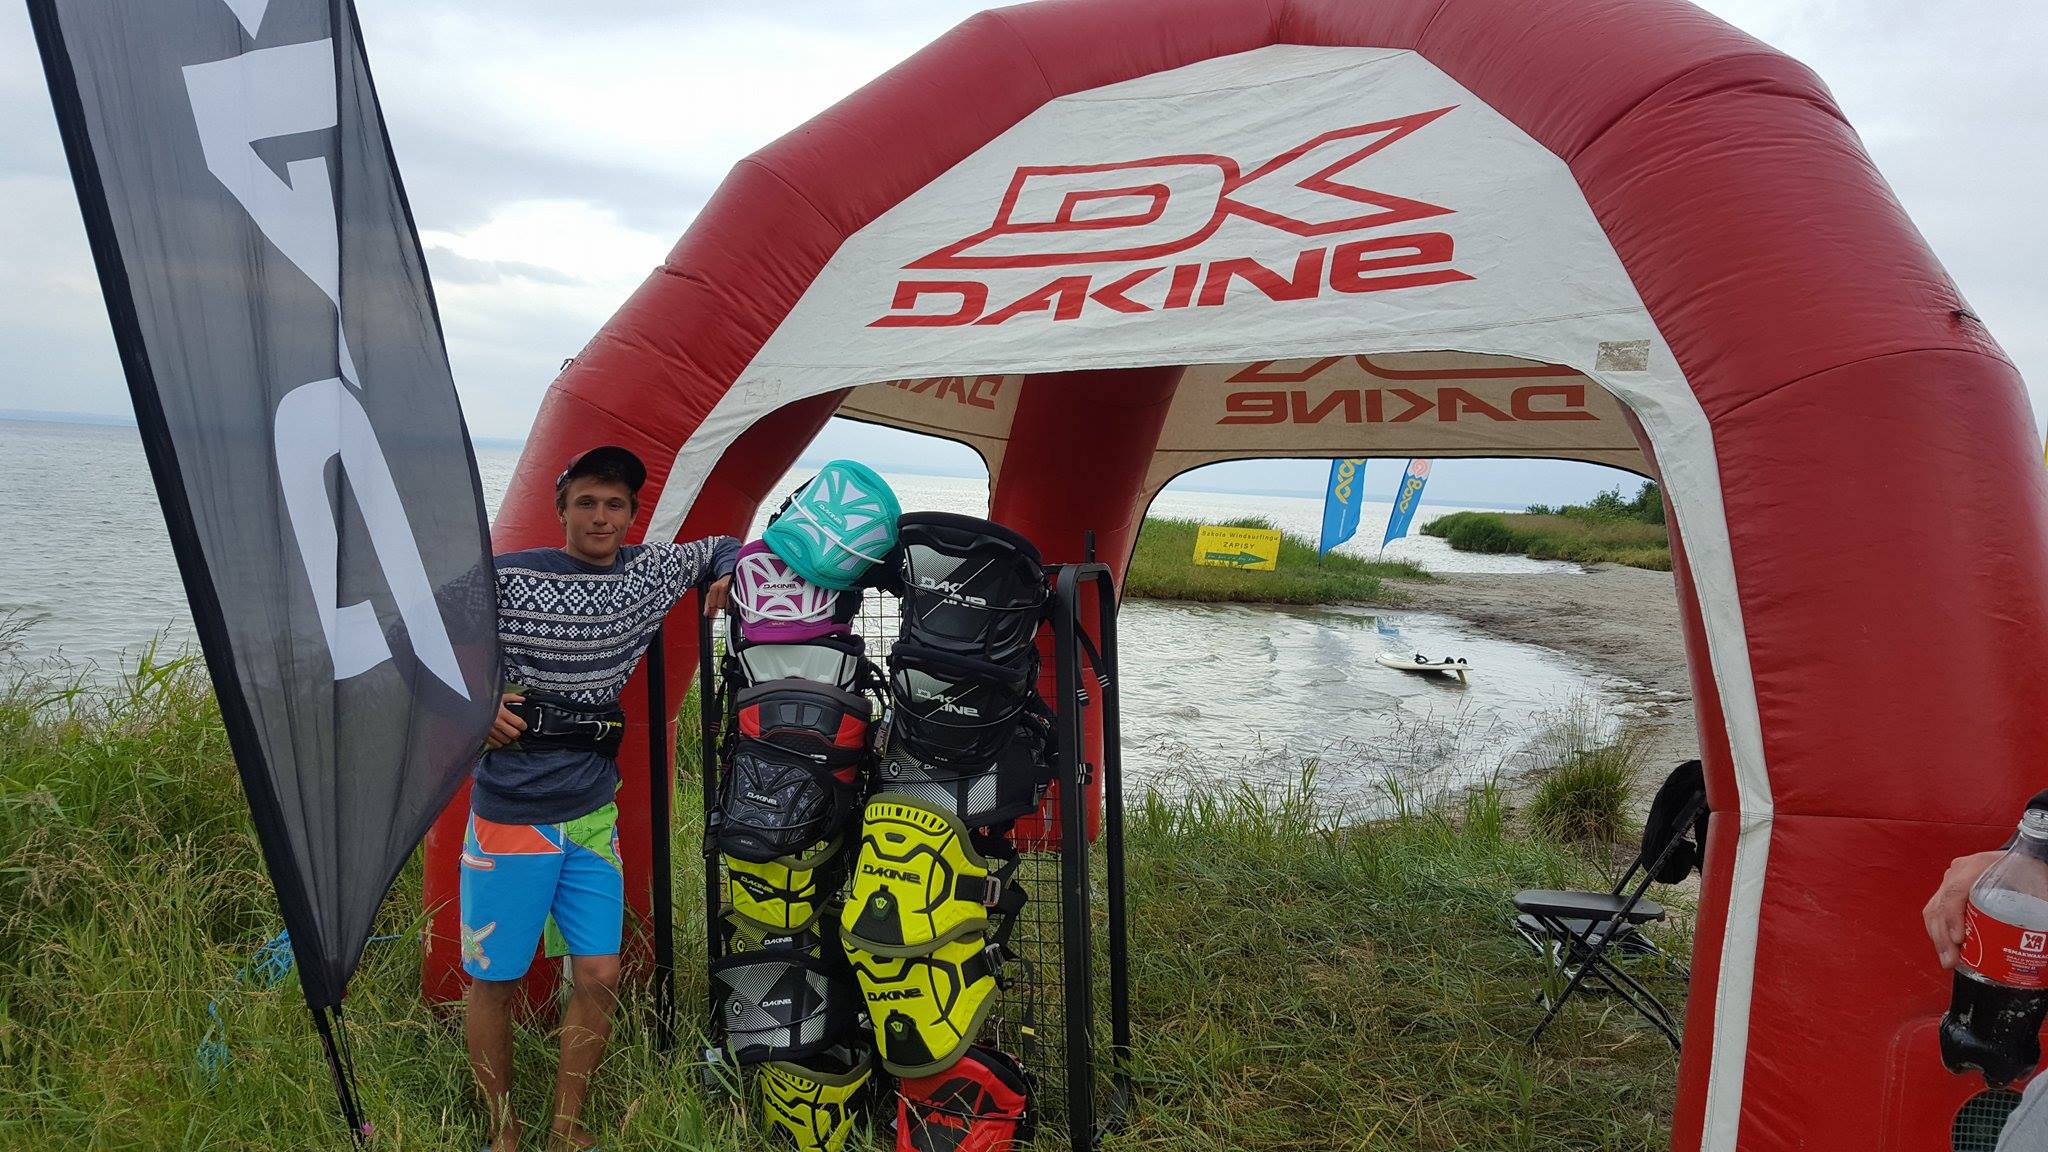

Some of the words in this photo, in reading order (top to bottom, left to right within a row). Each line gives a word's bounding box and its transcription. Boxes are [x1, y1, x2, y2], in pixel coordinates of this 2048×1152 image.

[865, 232, 1476, 328] DAKINE
[1222, 541, 1255, 550] ZAPISY
[747, 791, 778, 806] DAKINE
[862, 863, 922, 886] DAKINE
[764, 936, 793, 946] DAKINE
[867, 986, 925, 1003] DAKINE
[762, 998, 793, 1008] DAKINE
